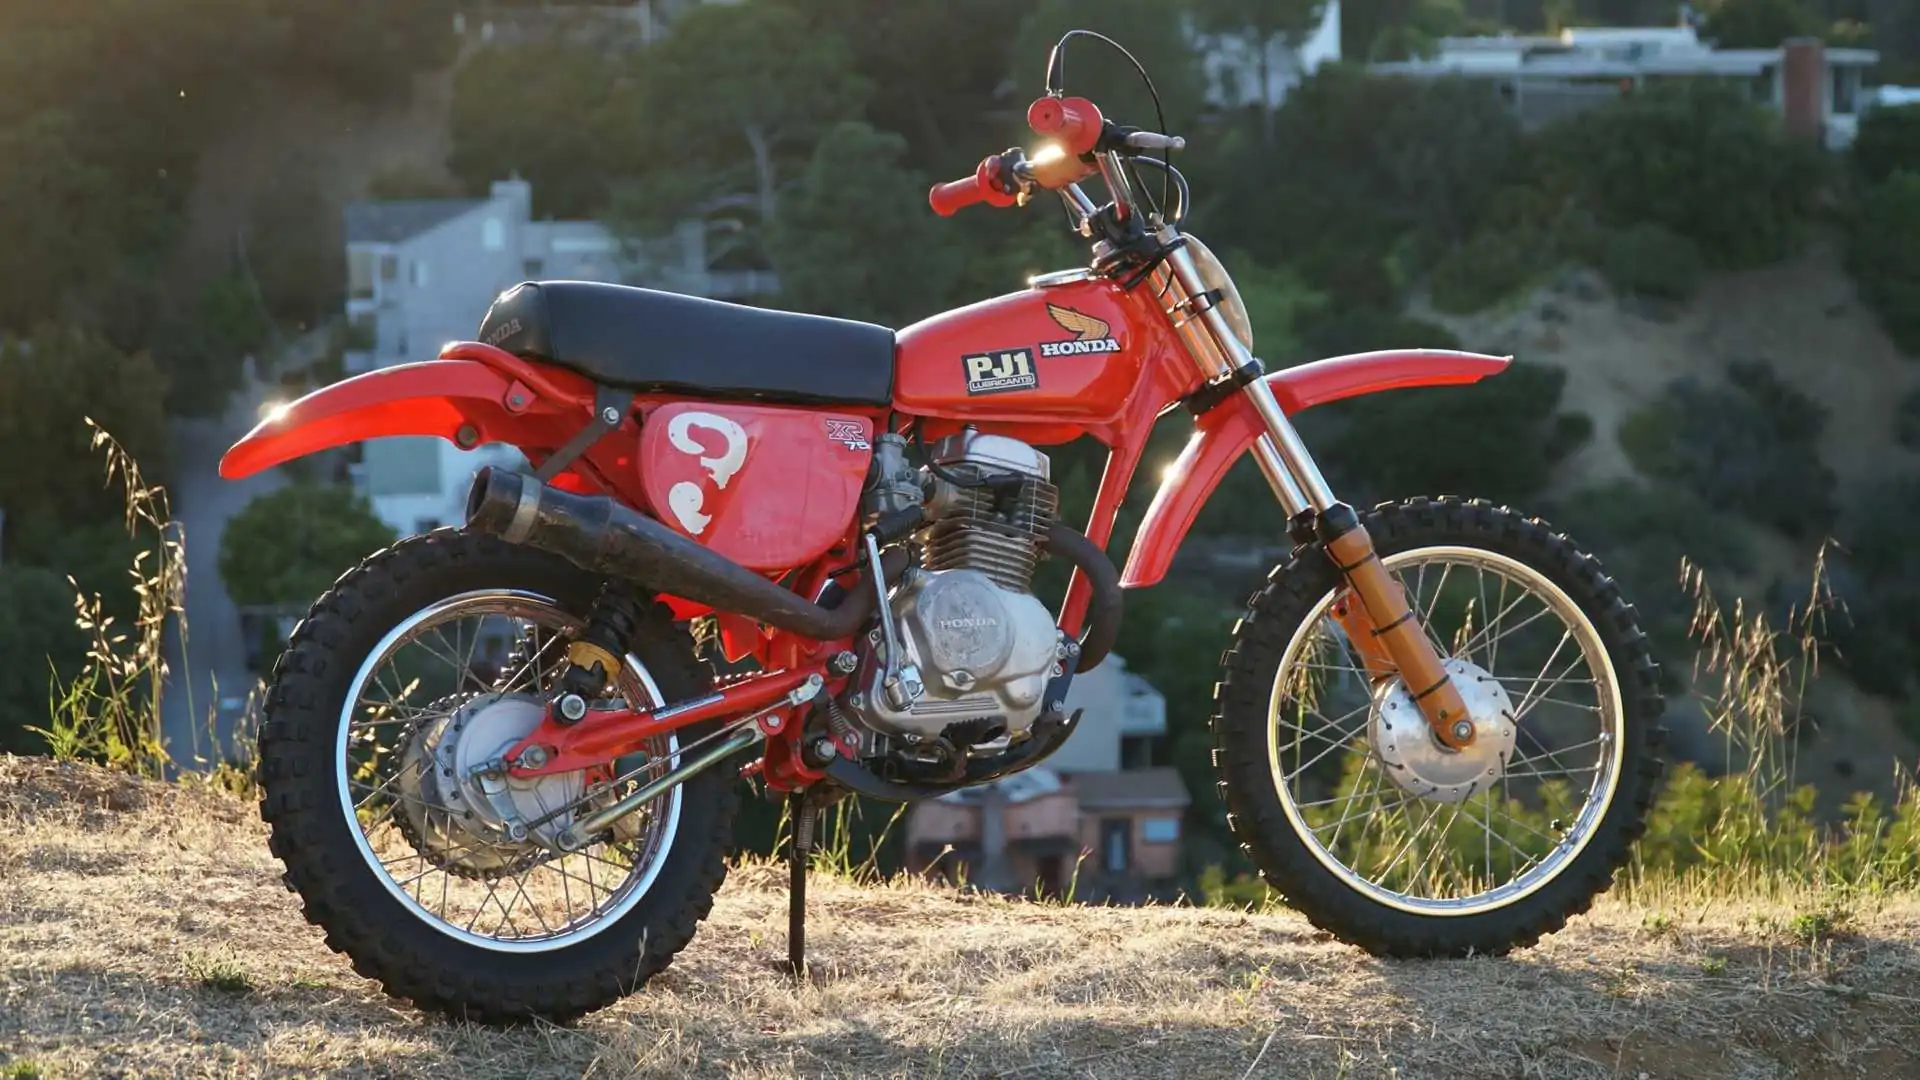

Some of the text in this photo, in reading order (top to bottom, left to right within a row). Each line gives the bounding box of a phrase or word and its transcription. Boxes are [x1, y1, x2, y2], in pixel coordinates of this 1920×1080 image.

[1040, 339, 1121, 356] HONDA
[967, 351, 1030, 381] PJ1
[972, 376, 1033, 389] LUBRICANTS
[826, 419, 865, 441] XR
[843, 440, 872, 452] 75
[940, 617, 998, 629] HONDA
